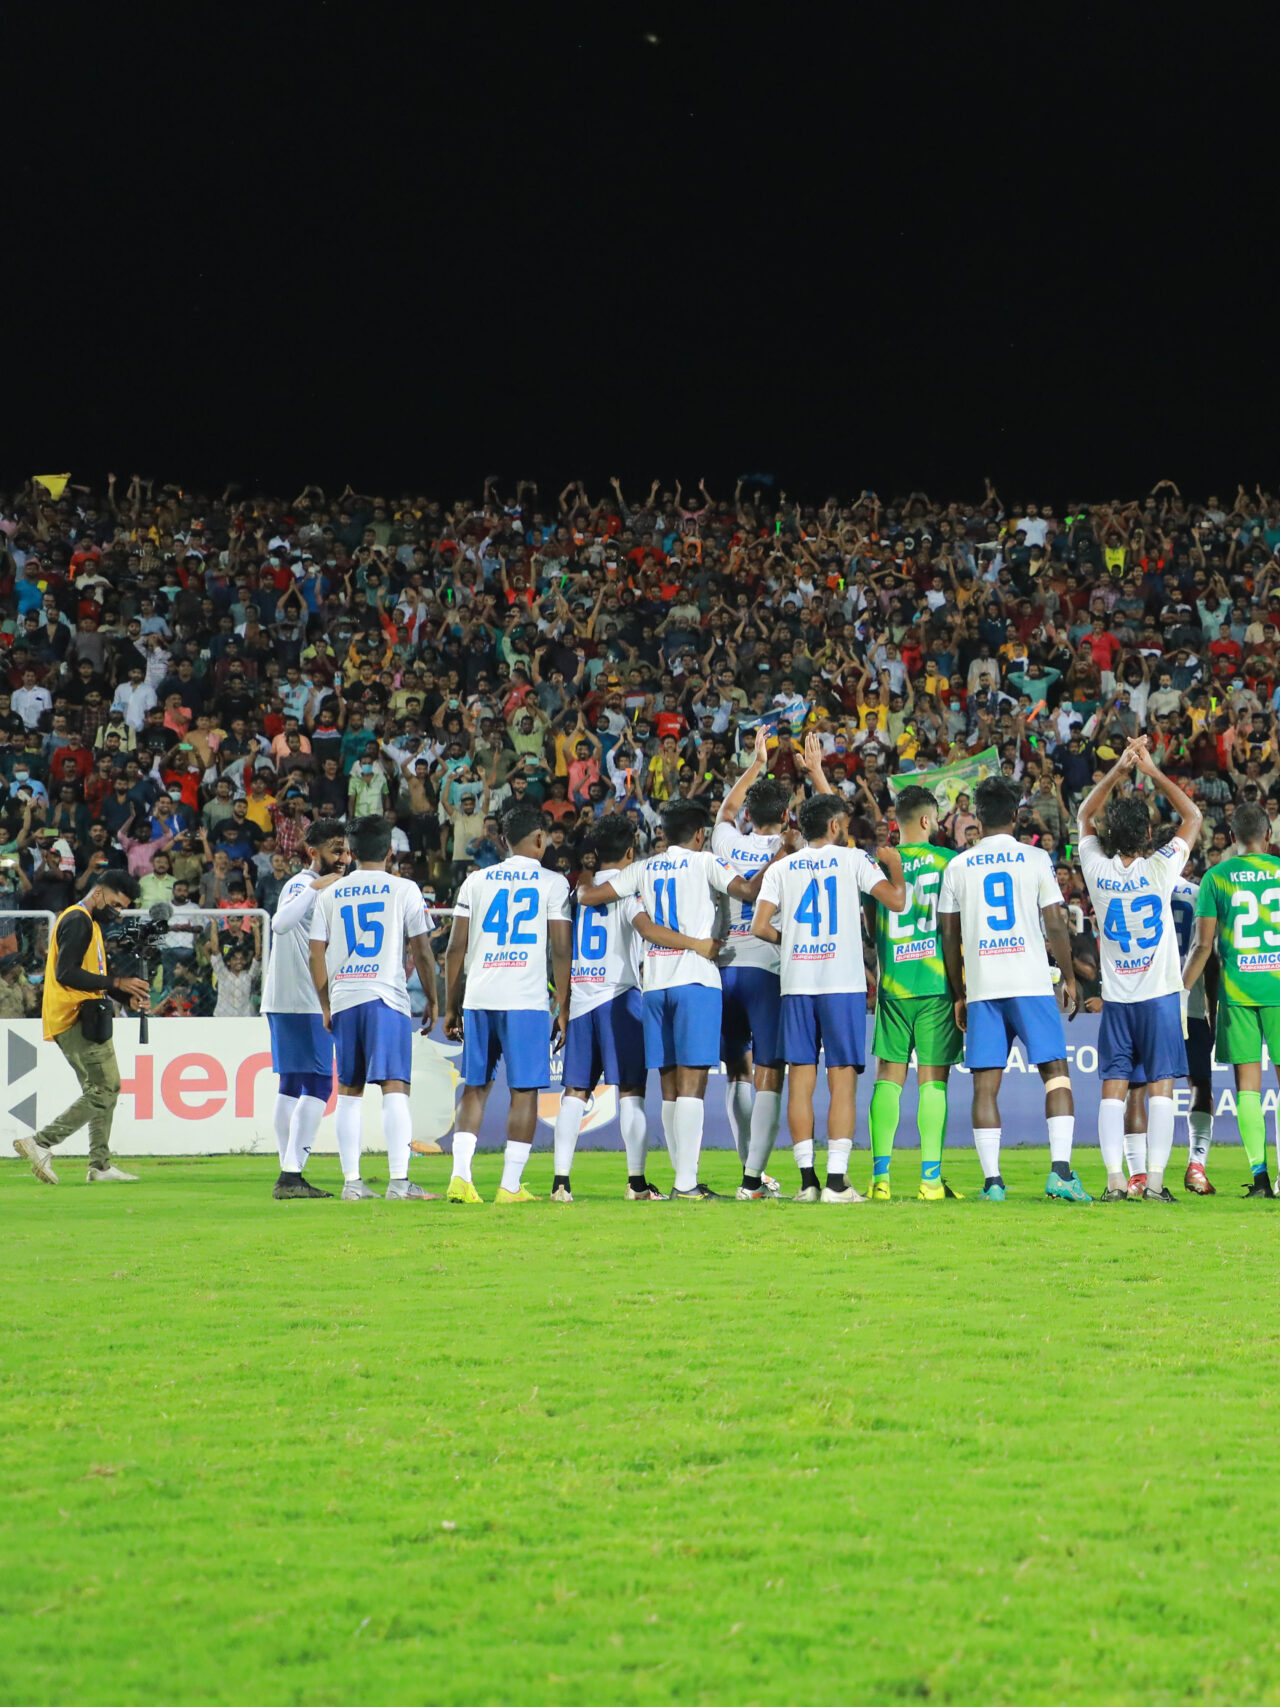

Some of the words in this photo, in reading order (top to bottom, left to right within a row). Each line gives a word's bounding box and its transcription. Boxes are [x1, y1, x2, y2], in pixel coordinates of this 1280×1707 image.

[902, 854, 934, 872] RALA
[967, 853, 1025, 867] KERALA
[486, 871, 539, 881] KERALA
[1097, 877, 1150, 892] KERALA
[334, 884, 391, 899] KERALA
[654, 878, 680, 932] 11
[794, 876, 838, 937] 41
[888, 872, 940, 939] 25
[983, 871, 1016, 931] 9
[482, 888, 539, 945] 42
[1104, 894, 1163, 953] 43
[340, 901, 385, 958] 15
[793, 943, 836, 953] RAMCO
[896, 939, 935, 954] RAMCO
[979, 937, 1025, 949] RAMCO
[1115, 955, 1155, 969] RAMC
[119, 1052, 337, 1120] Her
